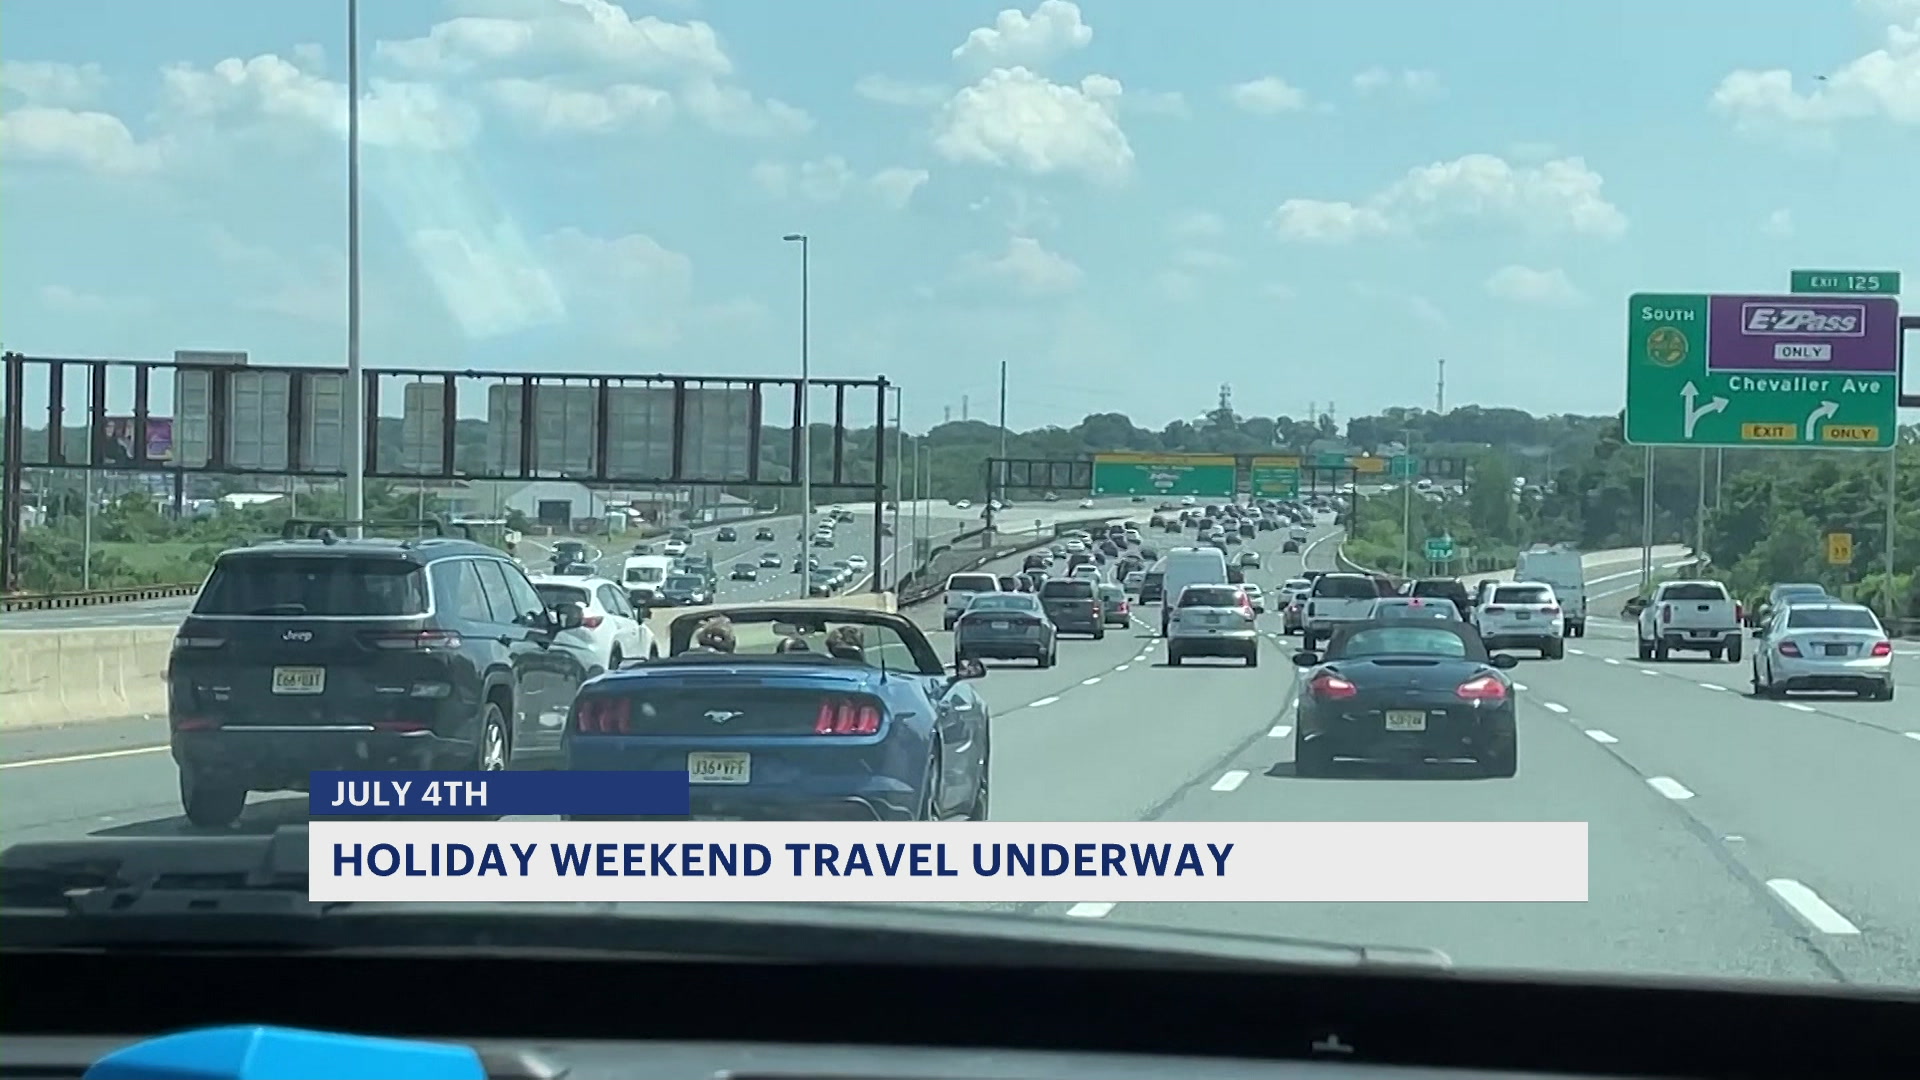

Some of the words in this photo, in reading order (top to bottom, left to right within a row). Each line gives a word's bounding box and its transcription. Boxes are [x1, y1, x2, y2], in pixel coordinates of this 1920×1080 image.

[1810, 276, 1838, 288] EXIT
[1847, 276, 1880, 291] 125
[1641, 306, 1695, 321] SOUTH
[1782, 346, 1822, 358] ONLY
[1841, 377, 1881, 394] Ave
[1752, 426, 1784, 438] EXIT
[1829, 428, 1871, 440] ONLY
[282, 629, 314, 643] Jeep
